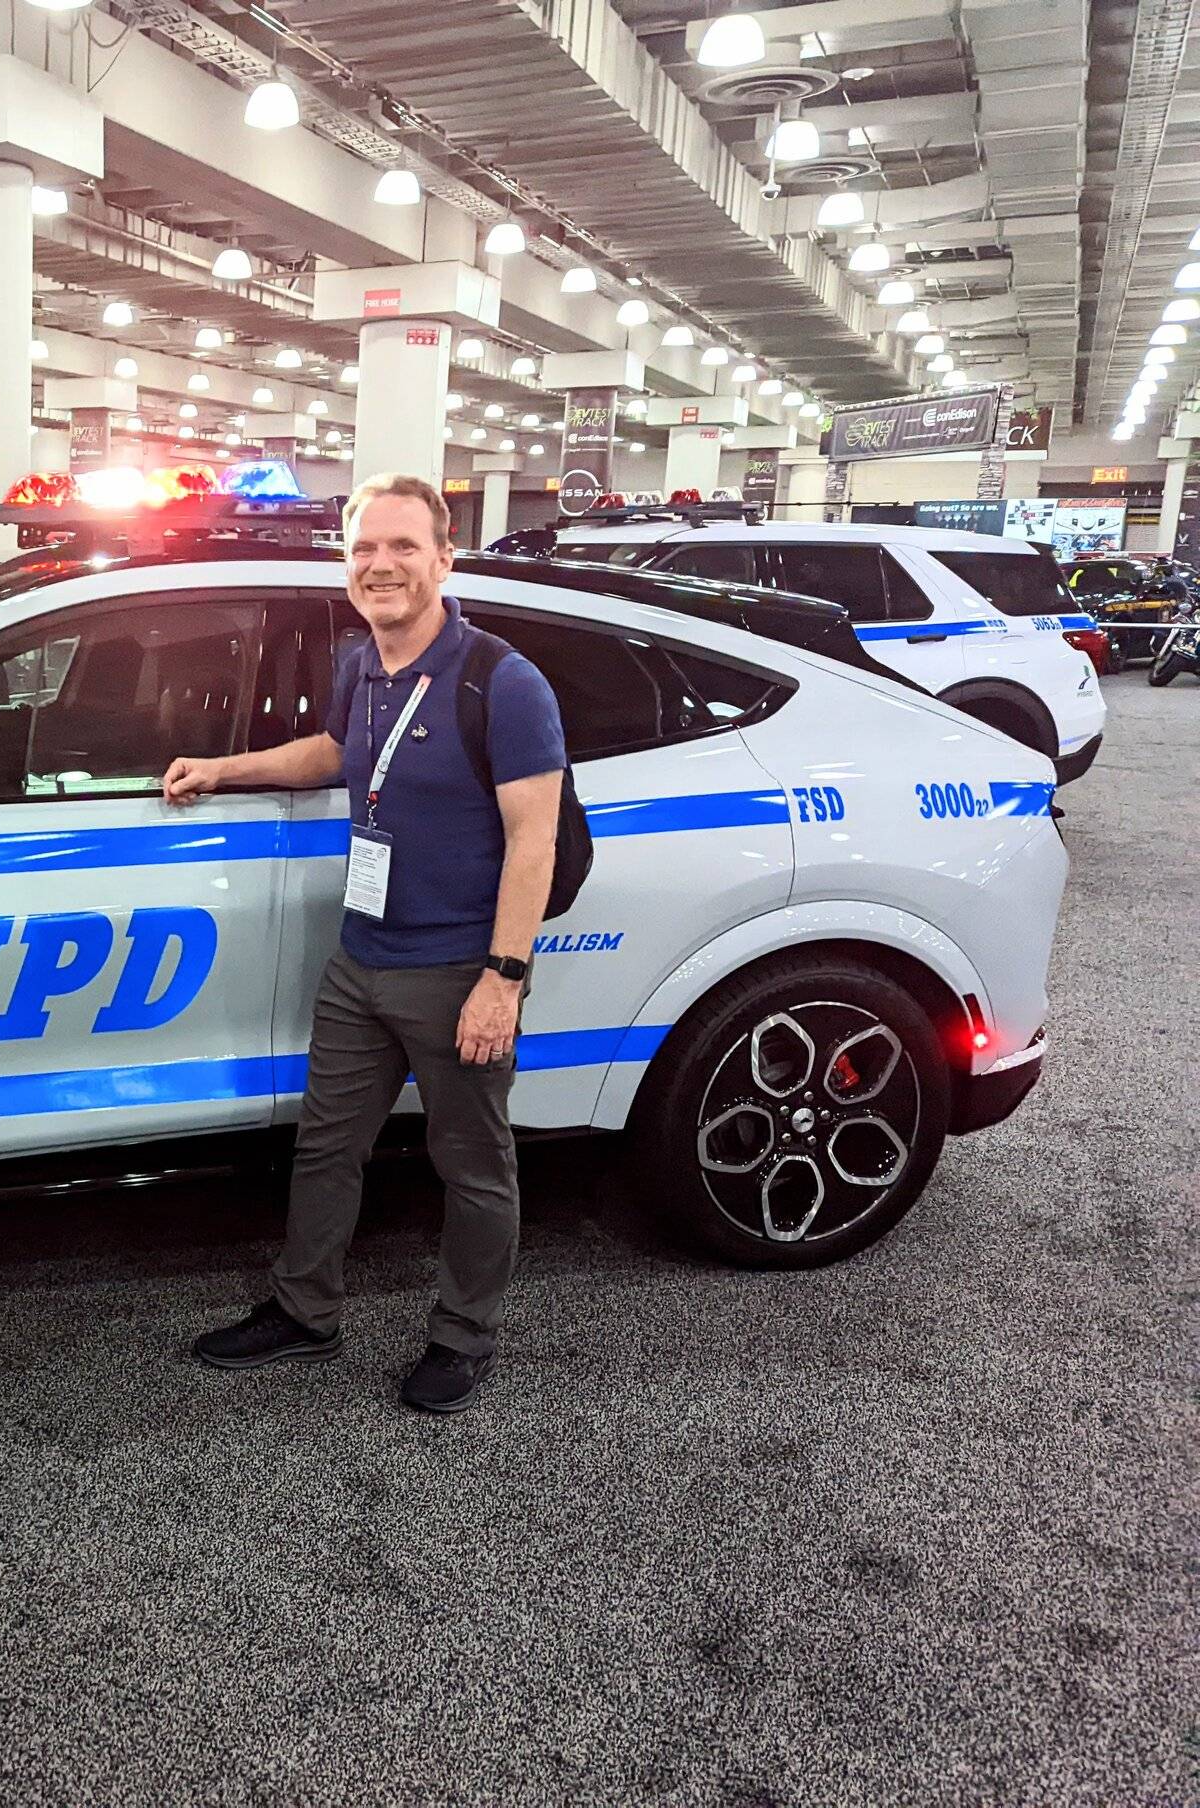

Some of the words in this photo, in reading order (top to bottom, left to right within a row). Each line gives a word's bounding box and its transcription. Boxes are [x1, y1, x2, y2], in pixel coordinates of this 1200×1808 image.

[574, 417, 606, 427] TRACK
[936, 408, 977, 422] conEdison
[860, 433, 889, 447] TRACK
[1094, 468, 1126, 482] Exit
[919, 504, 940, 514] Going
[941, 504, 960, 512] out?
[960, 504, 971, 512] So
[792, 786, 845, 823] FSD
